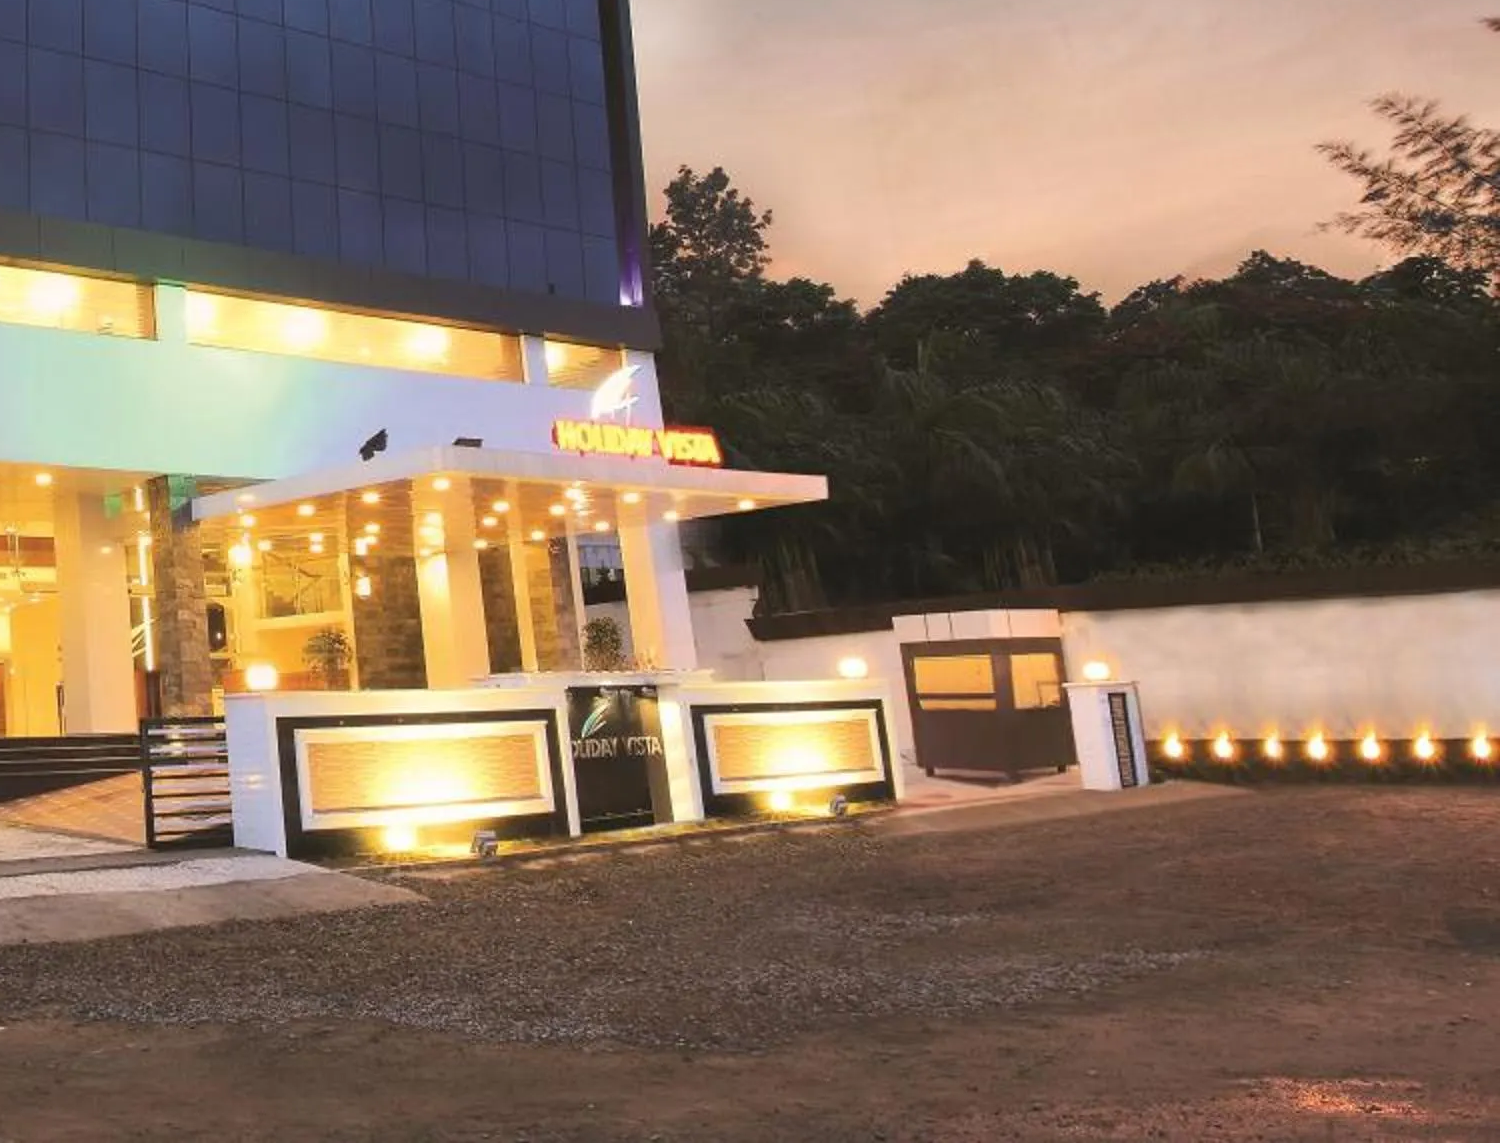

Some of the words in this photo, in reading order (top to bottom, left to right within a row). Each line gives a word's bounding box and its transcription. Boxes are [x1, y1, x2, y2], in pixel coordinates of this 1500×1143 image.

[553, 419, 653, 458] HOLIDAY
[655, 428, 723, 466] VISTA
[571, 737, 618, 759] OLIDAY
